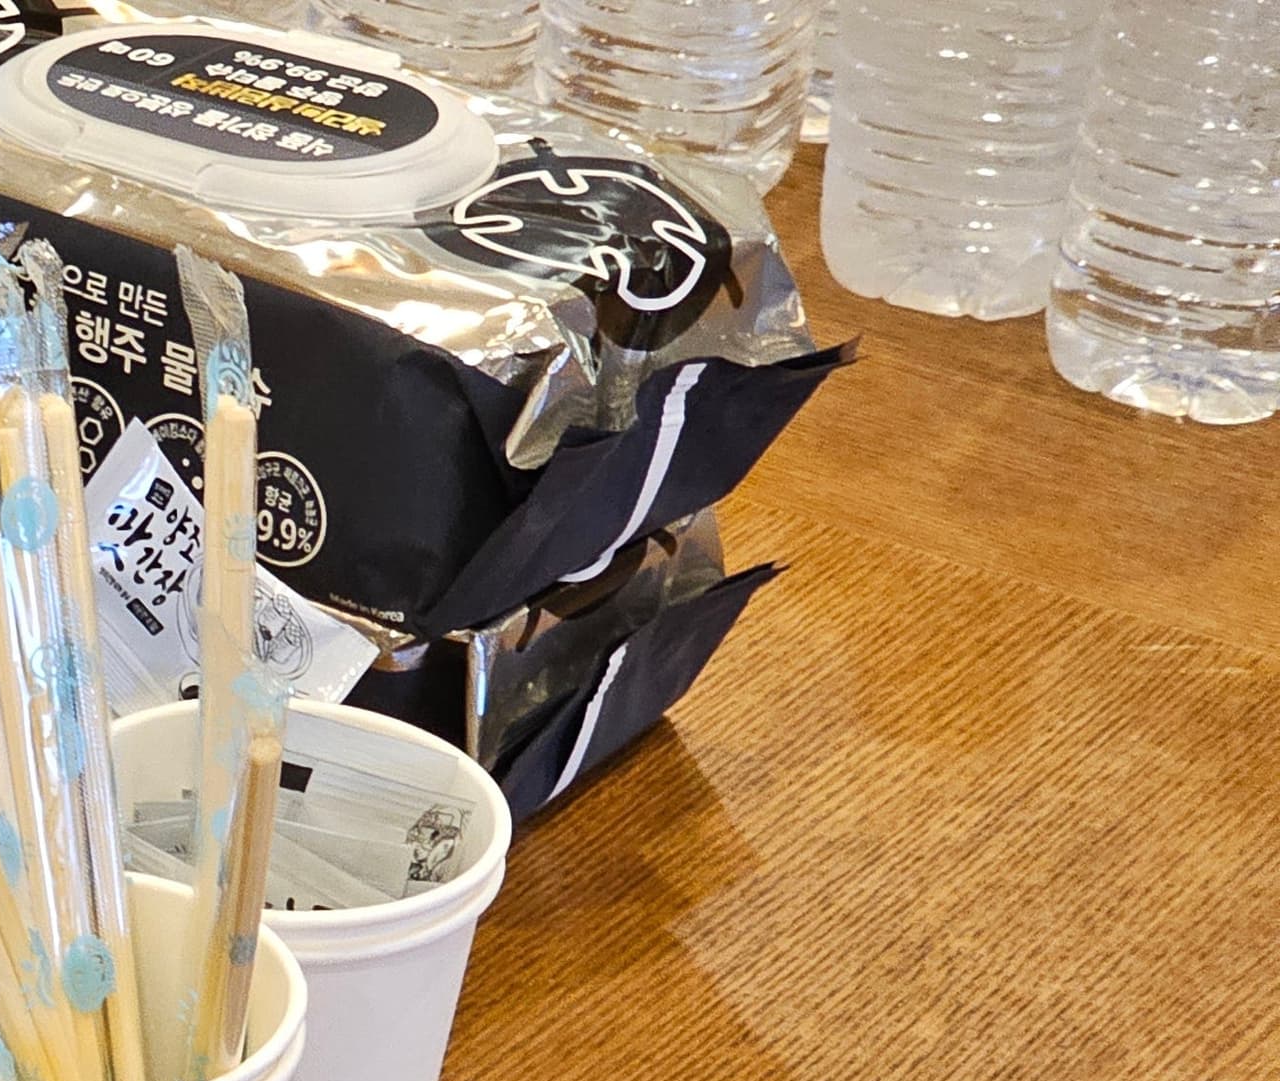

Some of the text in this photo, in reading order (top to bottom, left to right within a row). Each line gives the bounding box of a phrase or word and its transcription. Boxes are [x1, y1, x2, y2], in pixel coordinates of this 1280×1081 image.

[232, 50, 328, 81] 99.9%
[100, 84, 193, 117] 성분으로
[191, 109, 279, 141] 첨가물
[275, 130, 333, 156] 식품
[116, 279, 168, 328] 만든
[75, 310, 148, 375] 행주
[264, 484, 292, 513] 항균
[256, 508, 313, 553] 9.9%
